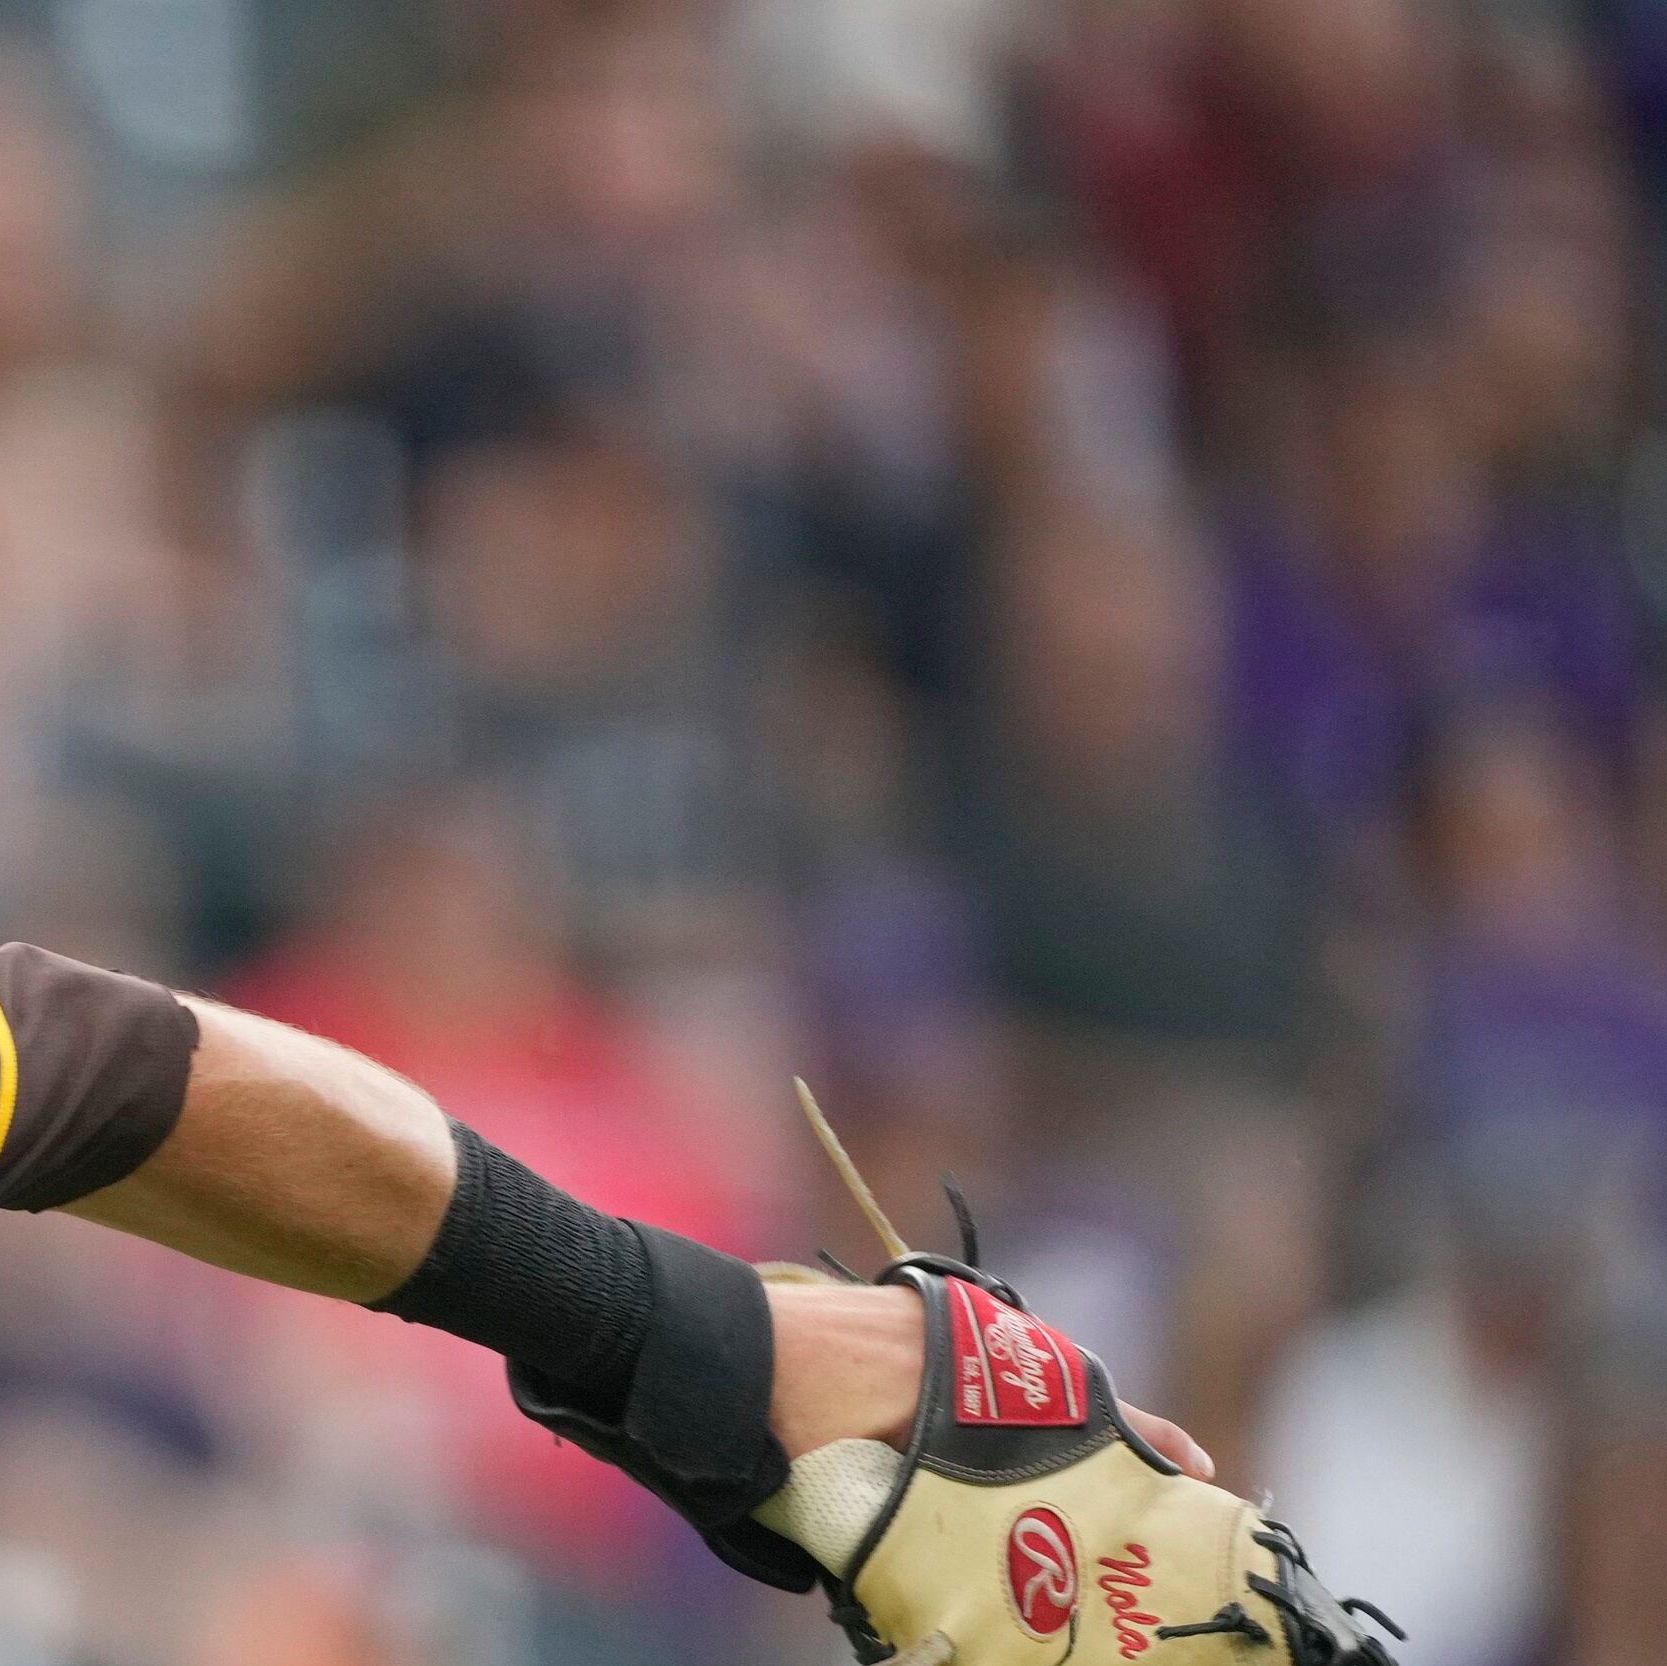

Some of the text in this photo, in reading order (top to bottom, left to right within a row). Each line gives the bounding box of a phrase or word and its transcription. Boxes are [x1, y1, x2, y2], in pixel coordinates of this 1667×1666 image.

[984, 1298, 1053, 1410] Rawlings
[1014, 1516, 1075, 1620] R
[1098, 1542, 1161, 1661] Nola
